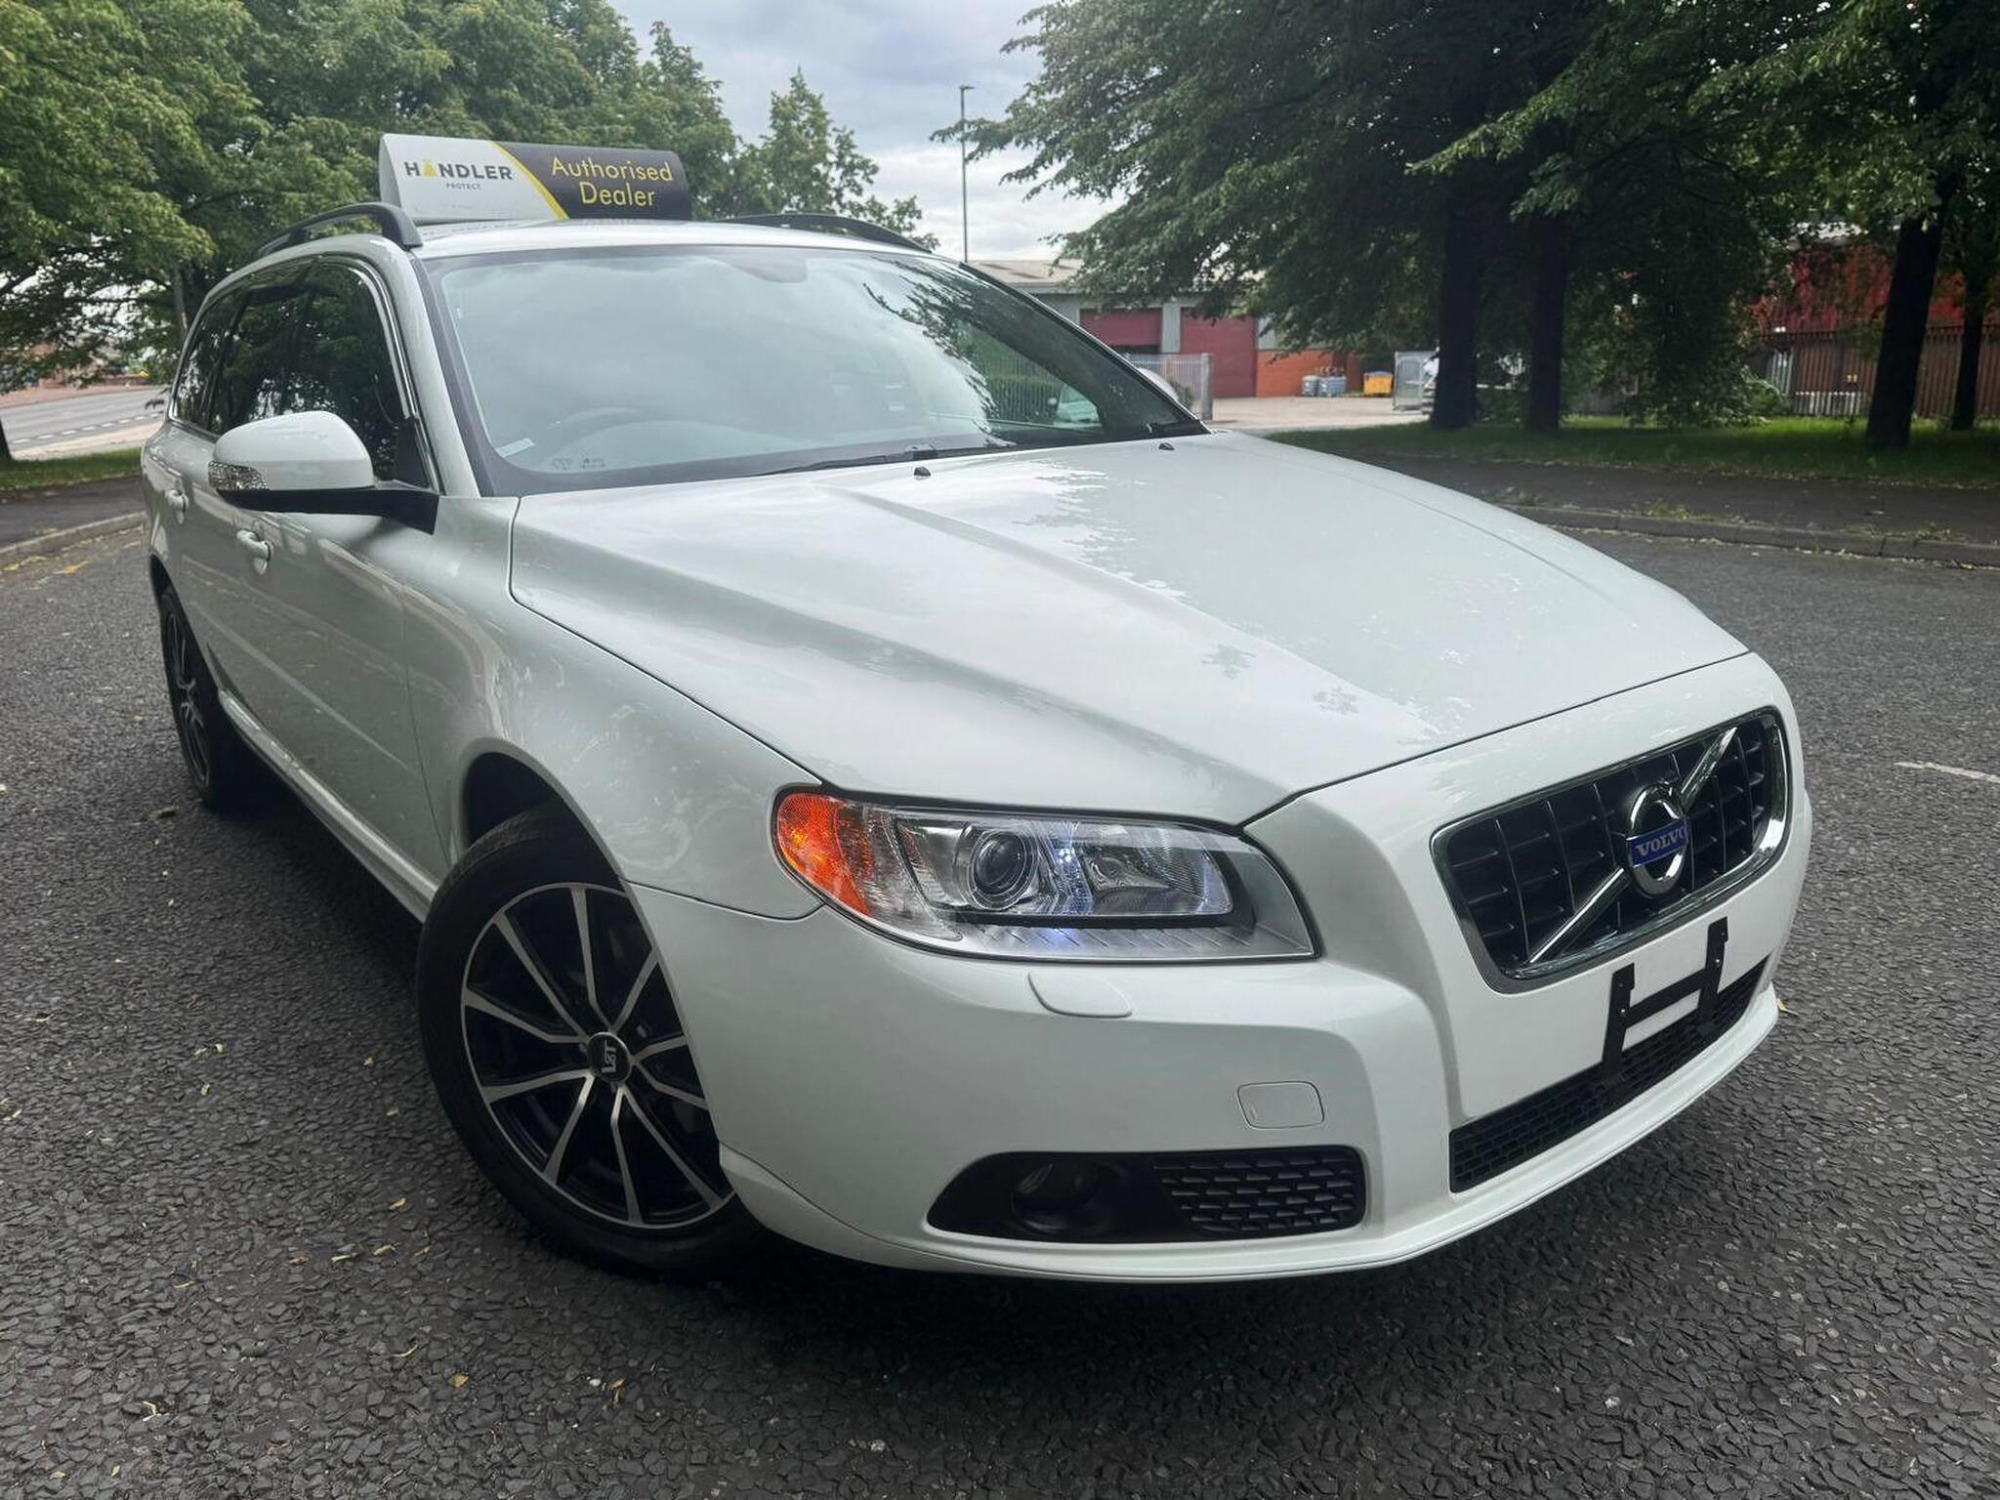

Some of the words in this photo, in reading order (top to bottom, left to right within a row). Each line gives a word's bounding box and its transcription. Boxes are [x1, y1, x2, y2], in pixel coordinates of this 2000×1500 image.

[552, 156, 673, 181] Authorised
[446, 182, 481, 191] PROTECT
[579, 181, 655, 206] Dealer
[1637, 827, 1687, 856] VOLVO
